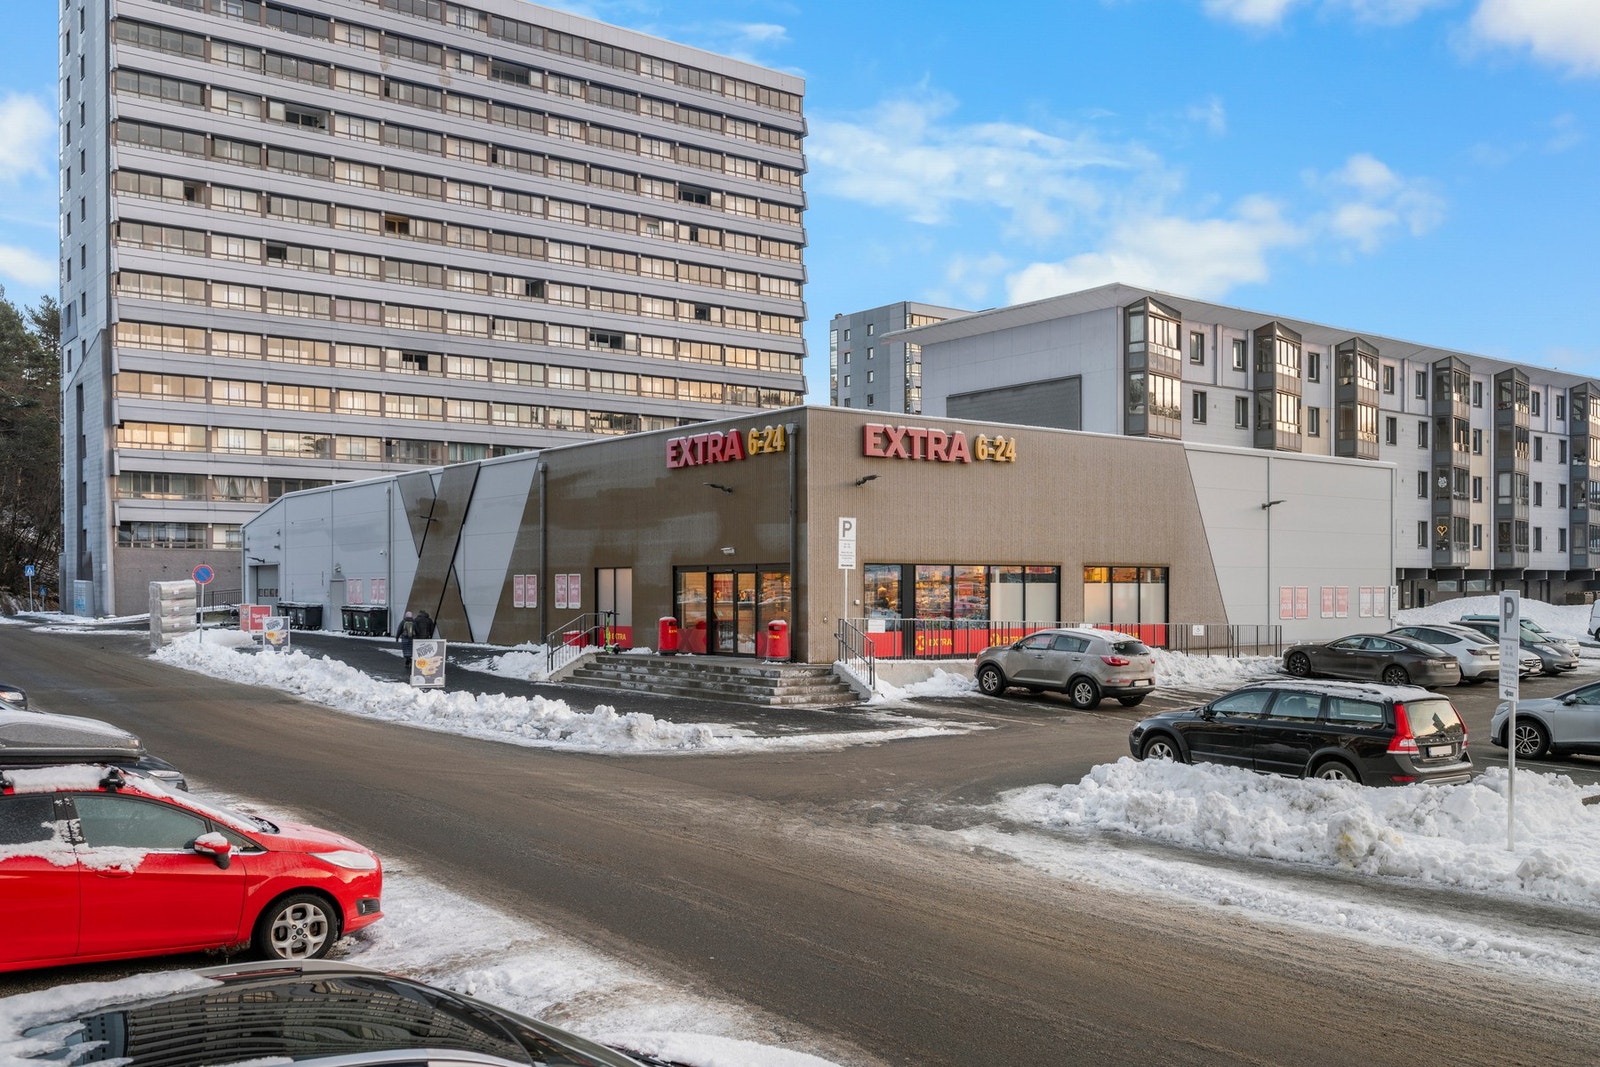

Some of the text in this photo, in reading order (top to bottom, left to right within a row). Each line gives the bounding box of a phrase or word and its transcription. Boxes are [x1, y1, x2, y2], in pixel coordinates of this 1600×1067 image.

[666, 424, 785, 469] EXTRA 6-24
[864, 423, 1016, 463] EXTRA 6-24
[842, 520, 852, 538] P
[1391, 587, 1397, 599] P
[1503, 596, 1515, 633] P
